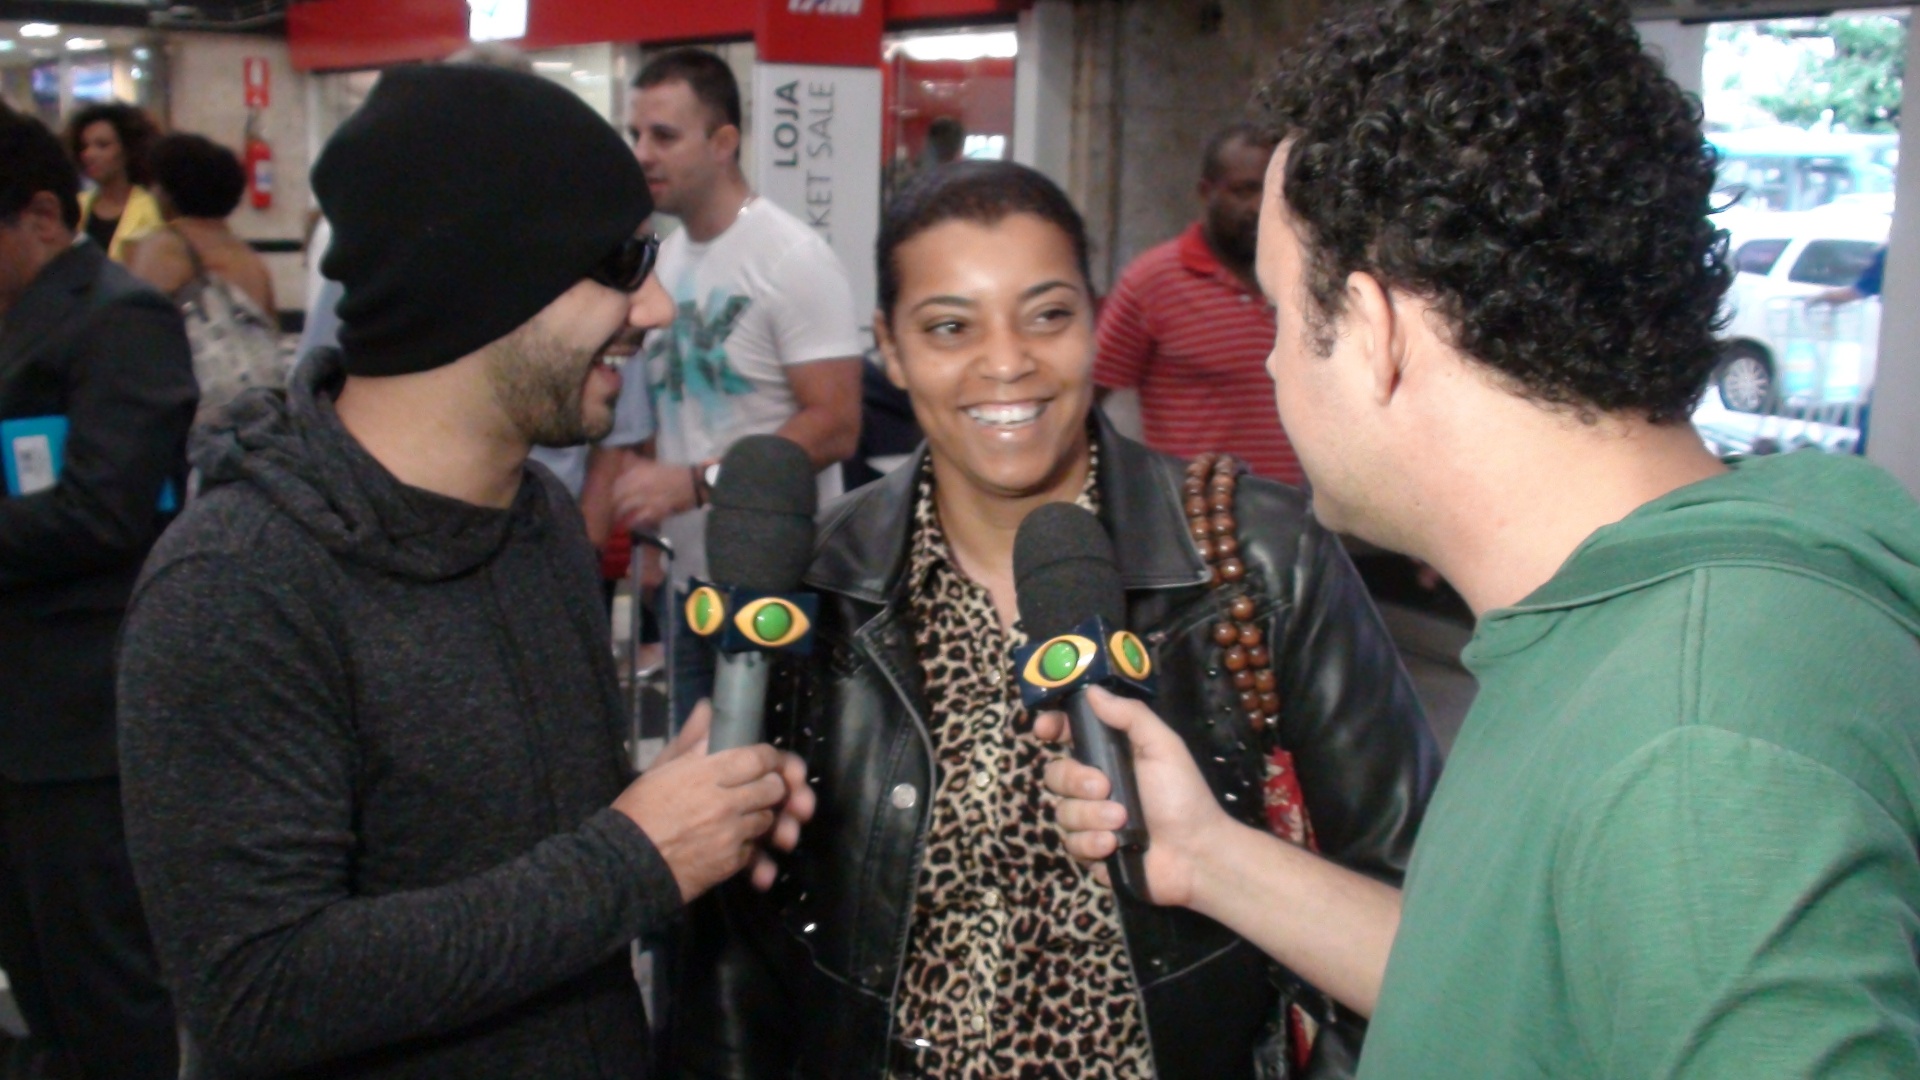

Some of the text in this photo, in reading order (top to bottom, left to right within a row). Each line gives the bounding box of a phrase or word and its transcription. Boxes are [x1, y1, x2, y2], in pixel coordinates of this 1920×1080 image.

[774, 80, 799, 167] LOJA
[806, 81, 834, 244] KET SALE
